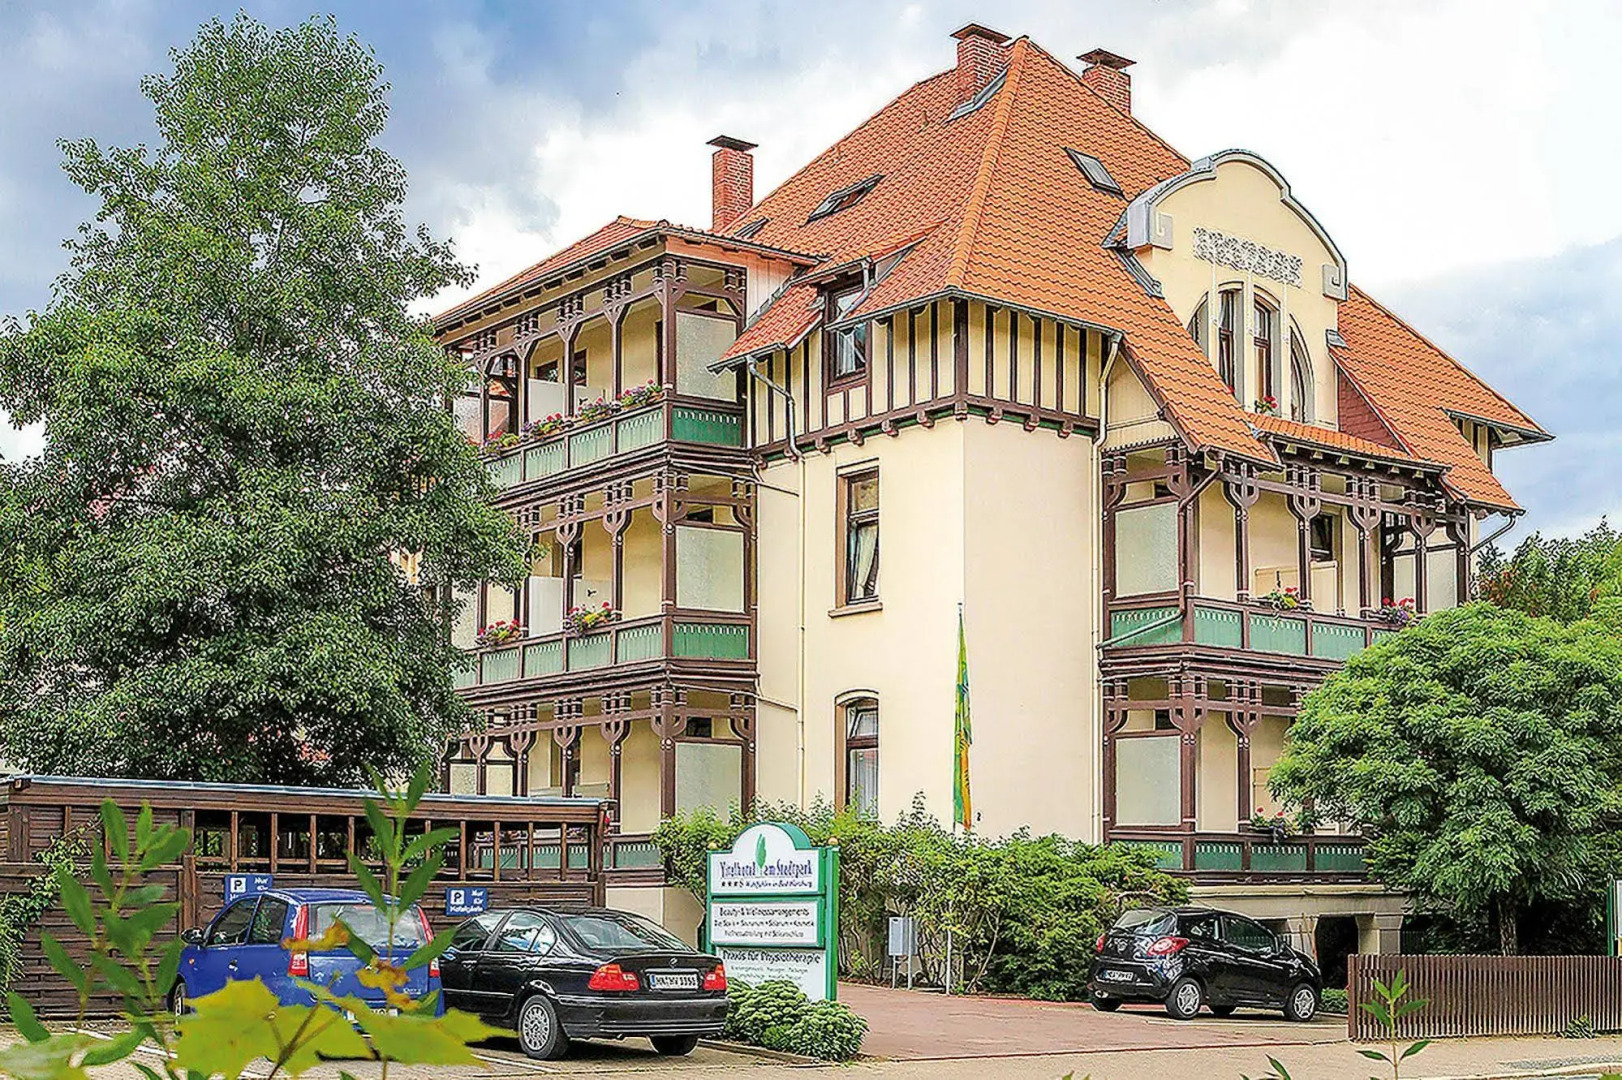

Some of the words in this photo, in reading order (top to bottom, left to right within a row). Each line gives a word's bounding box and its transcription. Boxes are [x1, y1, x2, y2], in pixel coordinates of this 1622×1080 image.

[722, 950, 746, 961] Praxis
[747, 950, 759, 961] für
[760, 951, 821, 965] Physiotherapie
